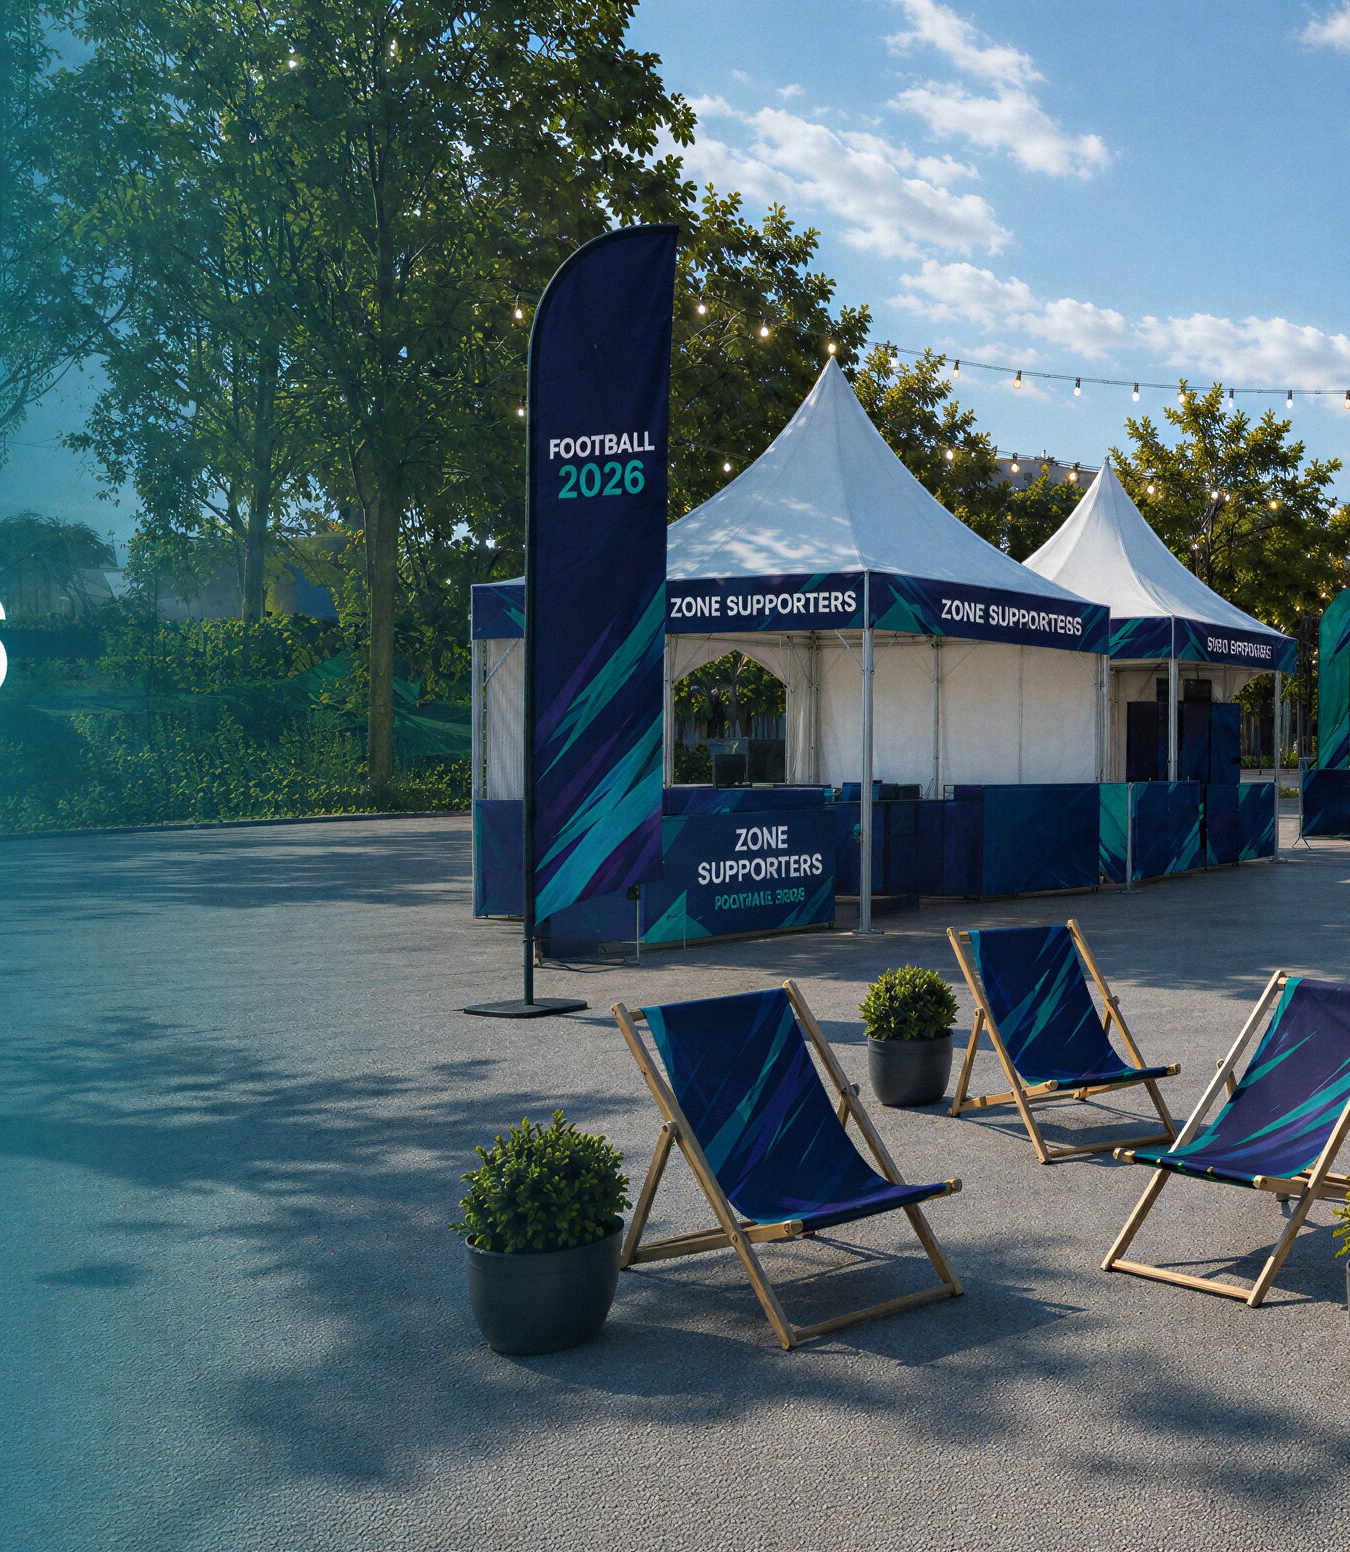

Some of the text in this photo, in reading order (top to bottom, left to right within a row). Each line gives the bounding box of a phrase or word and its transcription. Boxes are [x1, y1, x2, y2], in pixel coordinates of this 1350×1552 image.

[549, 431, 655, 459] FOOTBALL
[558, 459, 645, 499] 2026
[670, 591, 857, 618] ZONE SUPPORTERS
[941, 599, 985, 624] ZONE
[735, 825, 788, 852] ZONE
[697, 853, 823, 885] SUPPORTERS
